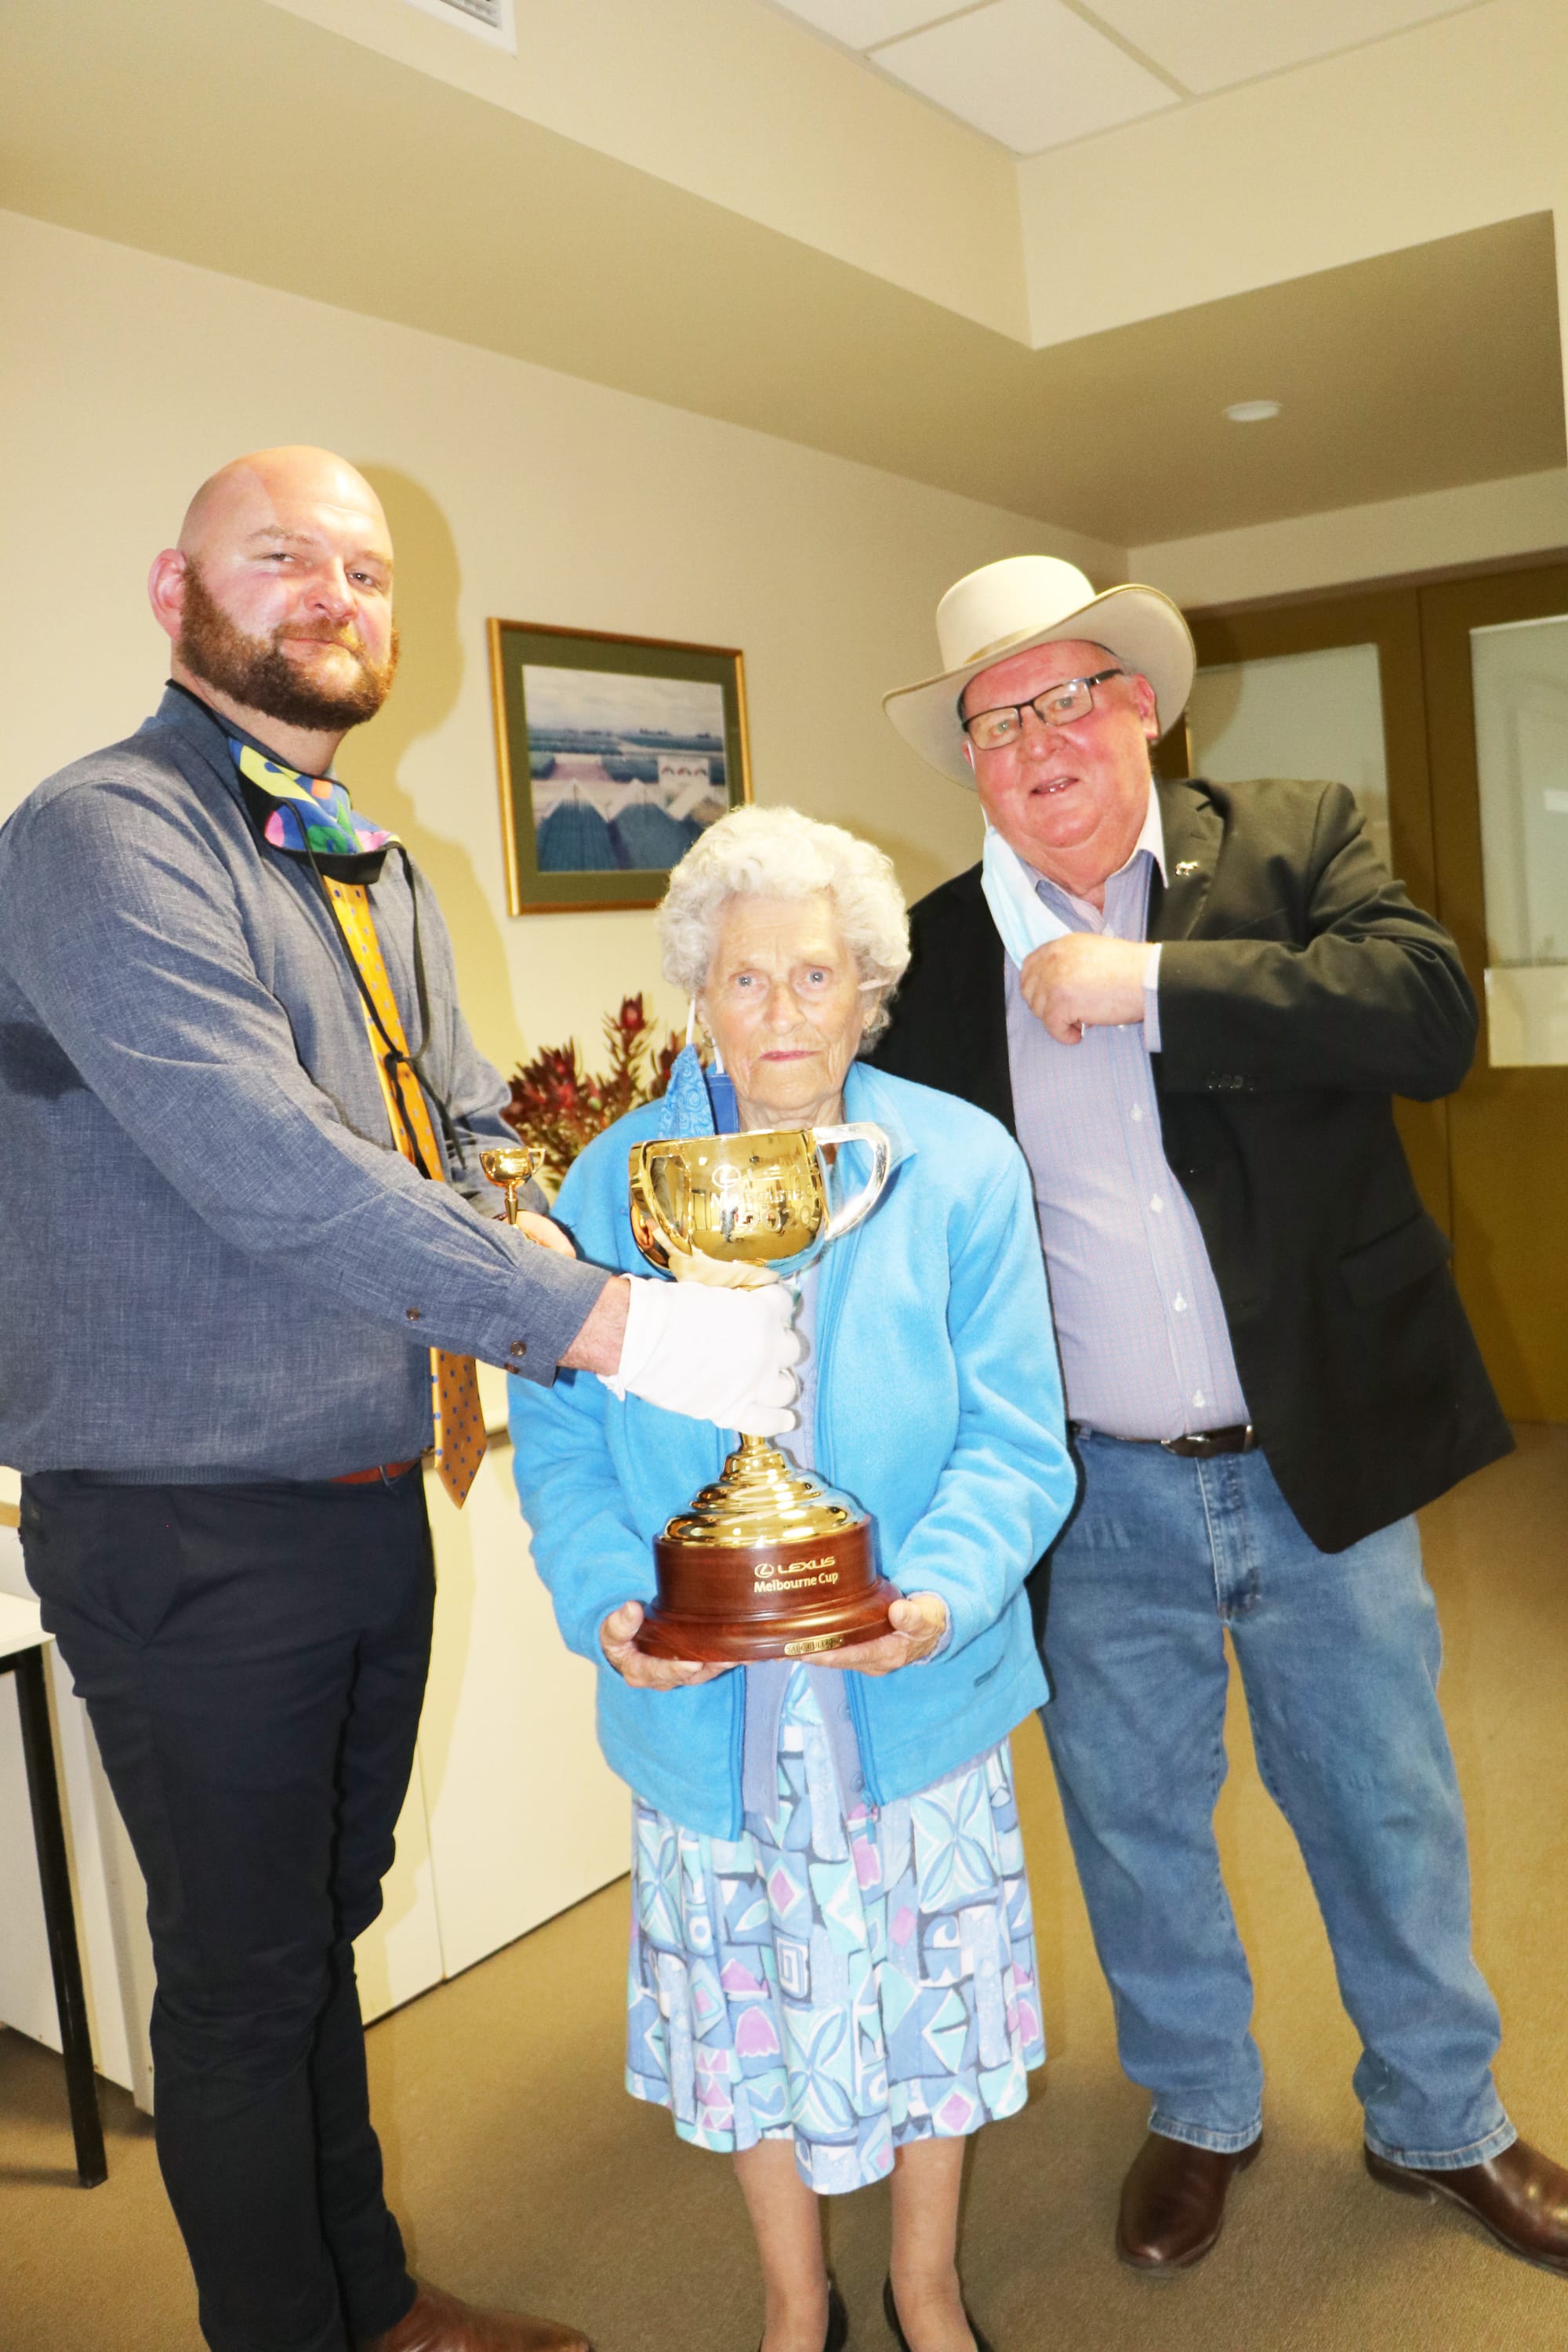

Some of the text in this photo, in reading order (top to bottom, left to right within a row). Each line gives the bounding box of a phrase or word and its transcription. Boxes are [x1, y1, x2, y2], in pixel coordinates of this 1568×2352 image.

[778, 1556, 836, 1573] LEXUS
[754, 1572, 838, 1593] Melbourne Cup
